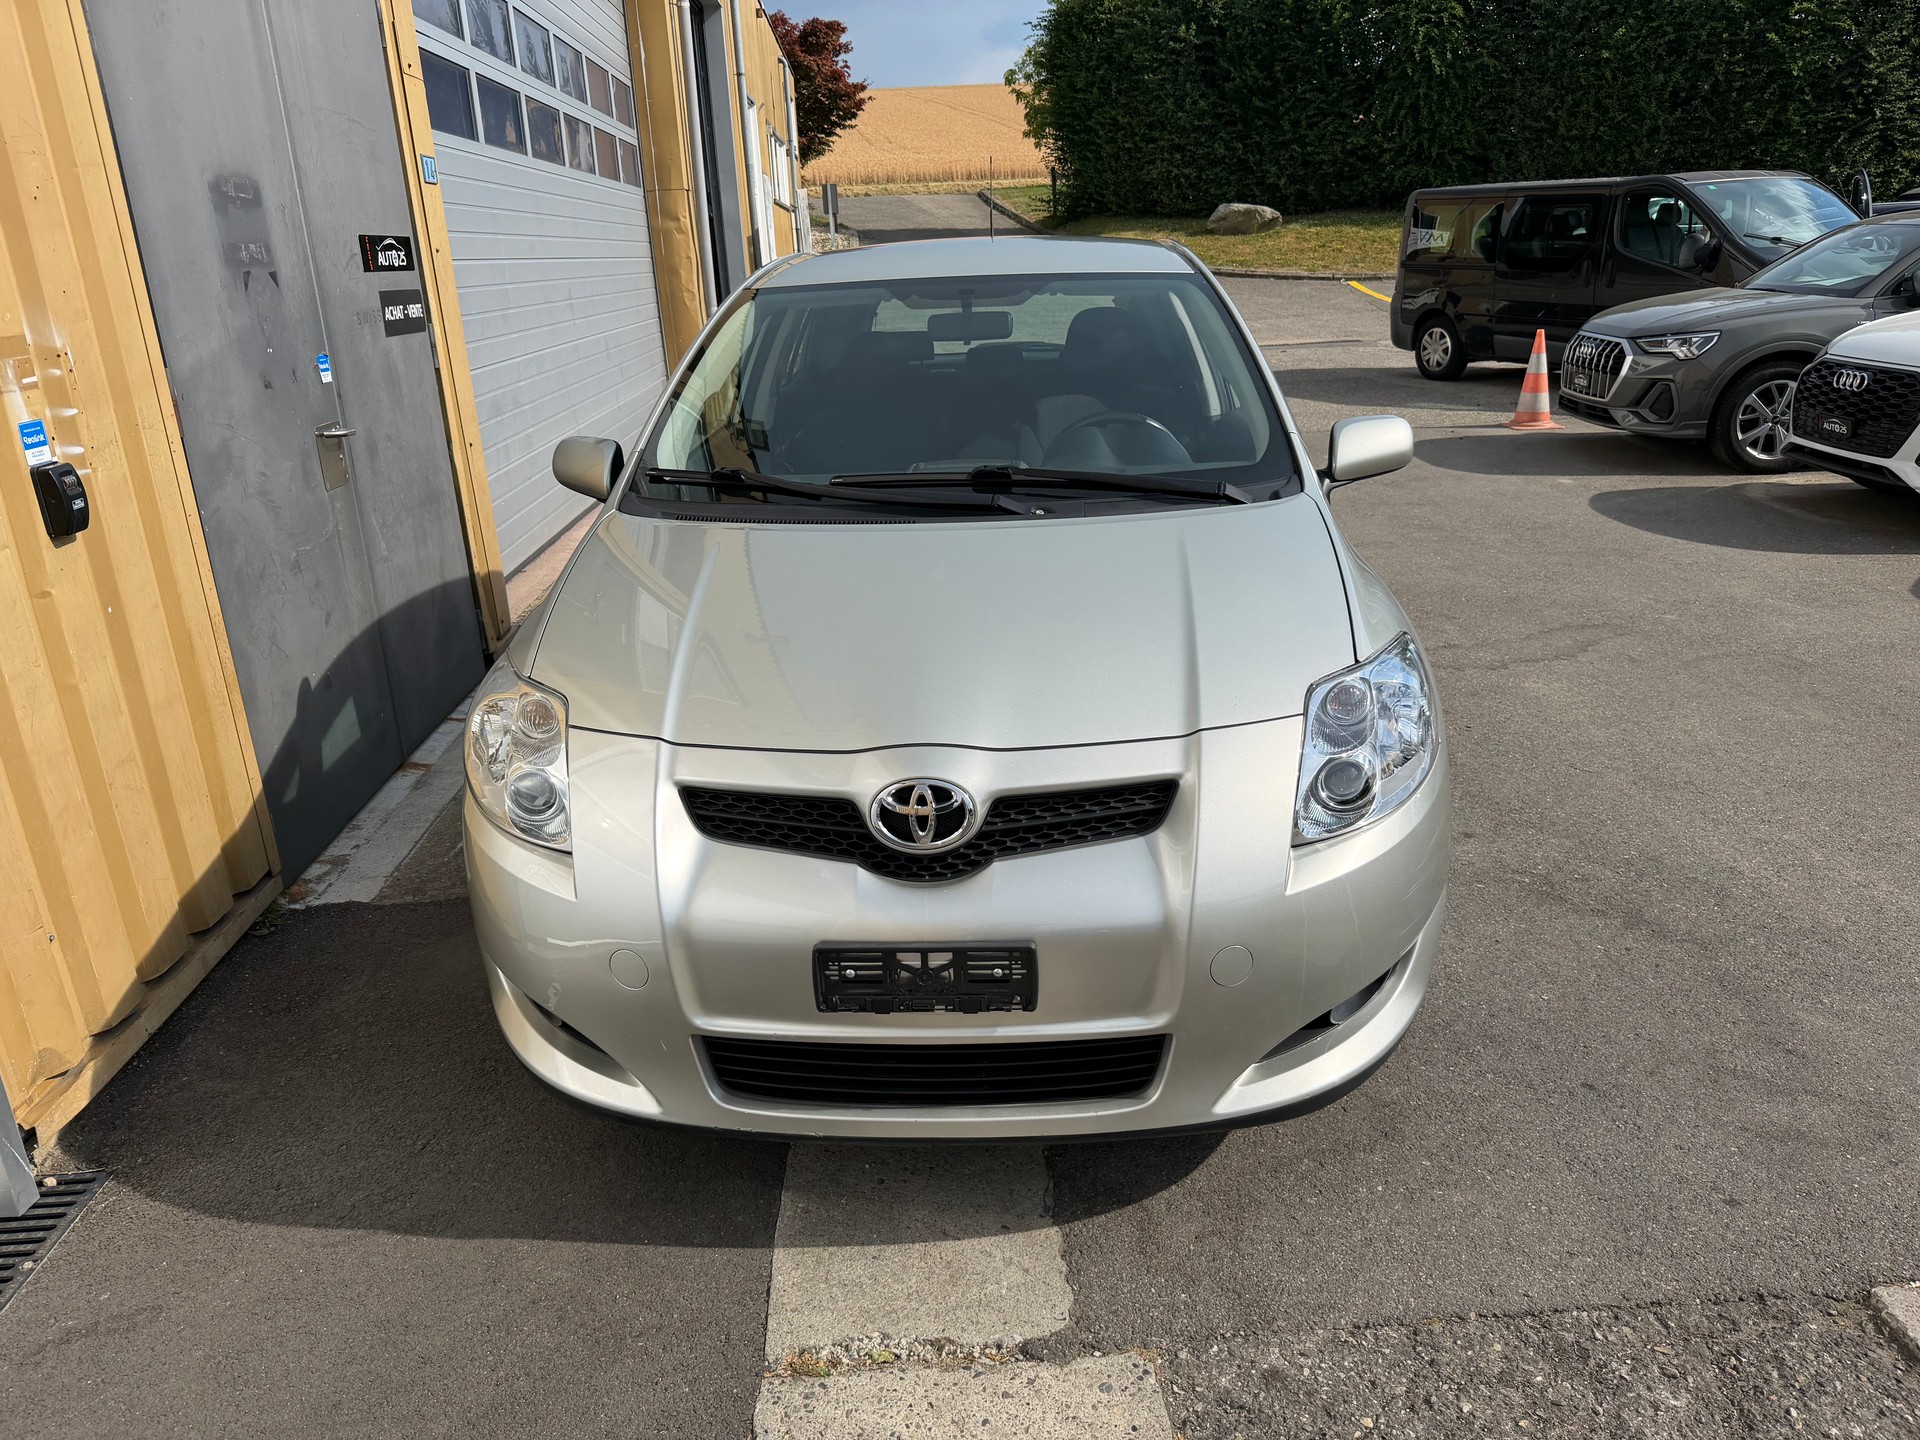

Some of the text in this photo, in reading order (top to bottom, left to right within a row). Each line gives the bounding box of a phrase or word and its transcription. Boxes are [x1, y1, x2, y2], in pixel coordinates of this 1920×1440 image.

[385, 305, 404, 321] ACHAT
[407, 303, 424, 318] VENTE
[23, 433, 46, 445] Reolink
